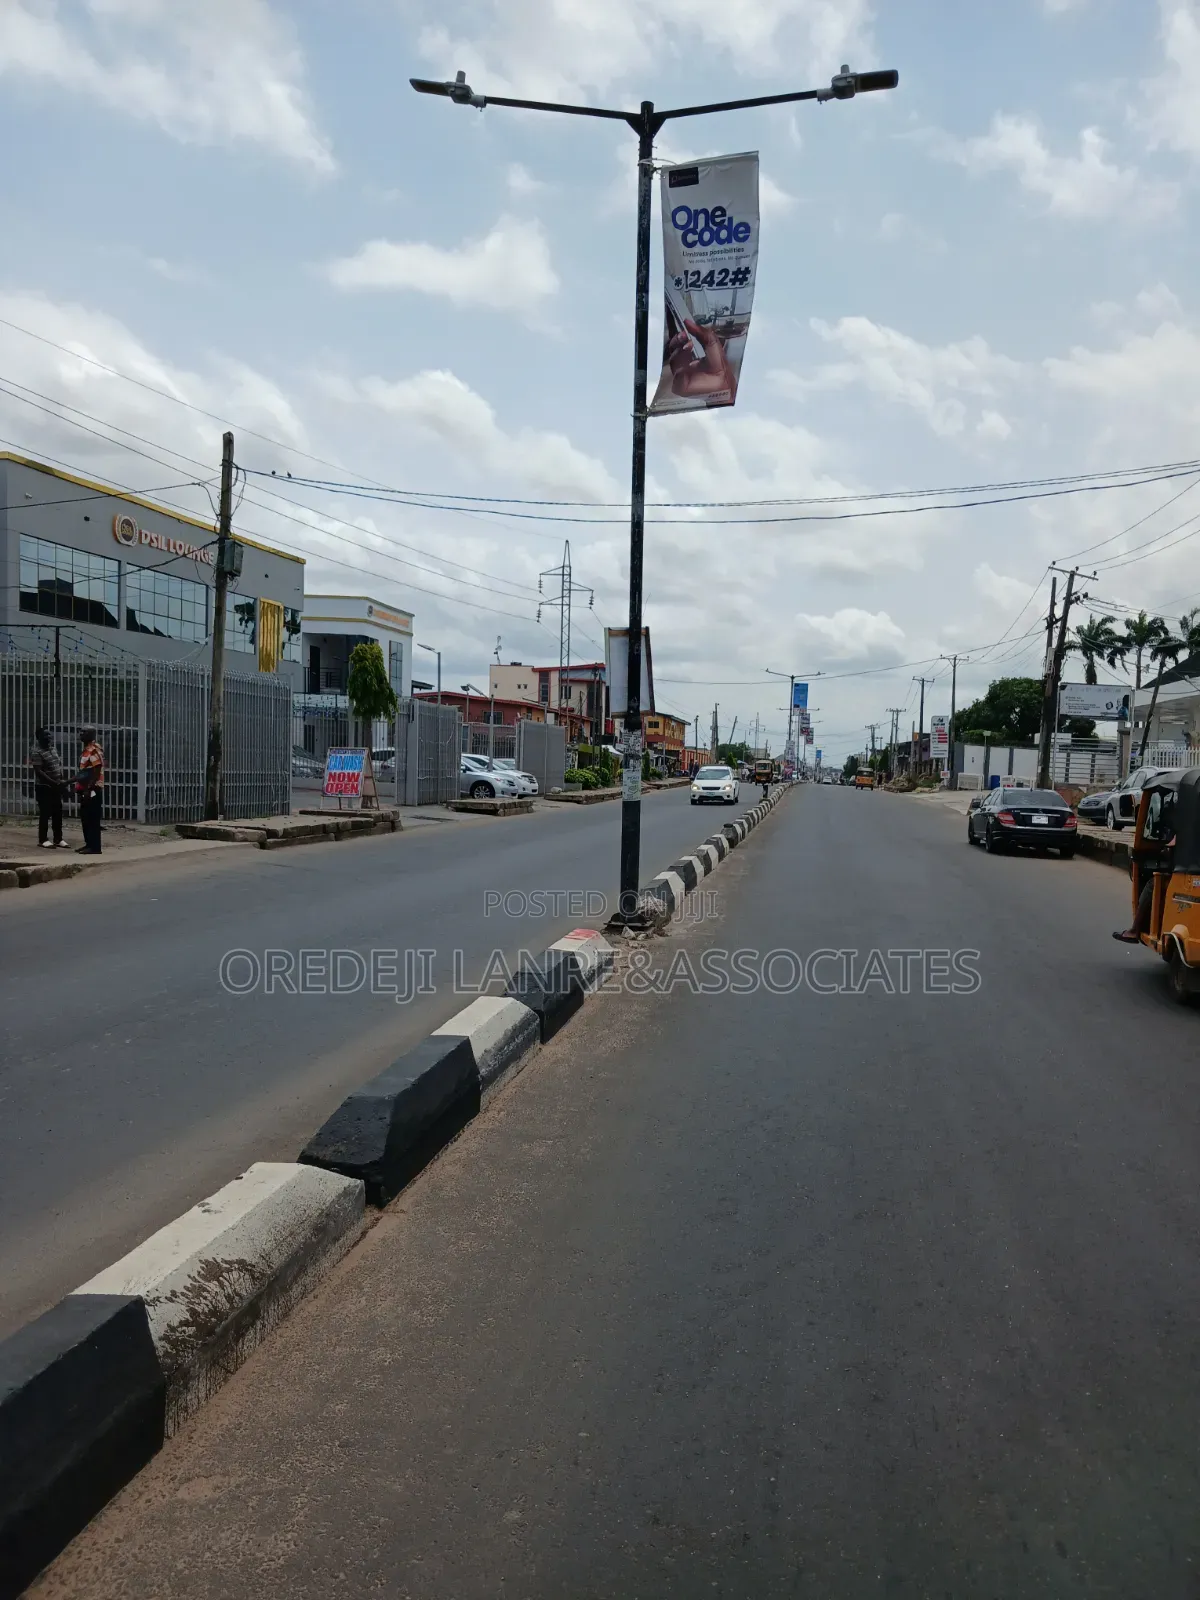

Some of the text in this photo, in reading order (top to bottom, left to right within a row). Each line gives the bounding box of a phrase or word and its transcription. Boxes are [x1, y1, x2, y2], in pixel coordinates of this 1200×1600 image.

[671, 205, 727, 231] One
[681, 216, 751, 249] code
[139, 529, 168, 553] DSIL
[168, 538, 215, 567] LOUNGE
[325, 782, 360, 794] OPEN
[327, 771, 361, 783] NOW
